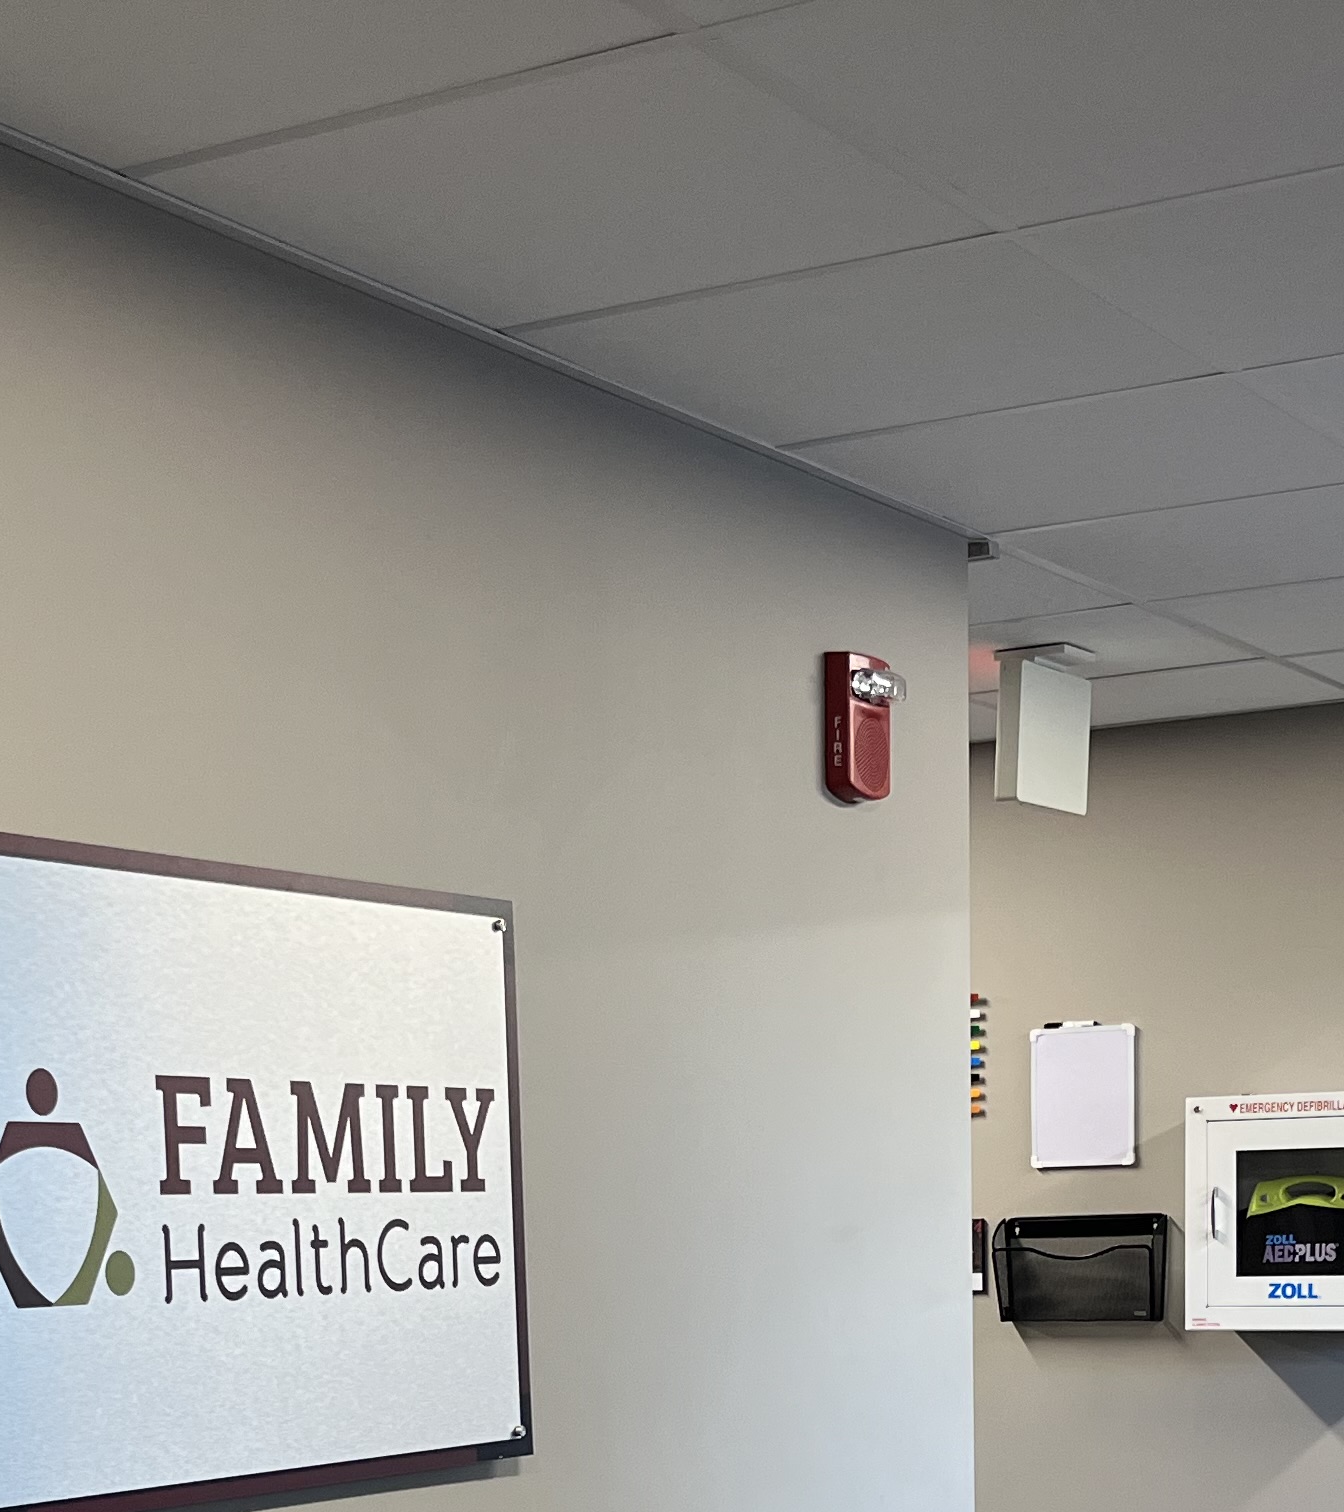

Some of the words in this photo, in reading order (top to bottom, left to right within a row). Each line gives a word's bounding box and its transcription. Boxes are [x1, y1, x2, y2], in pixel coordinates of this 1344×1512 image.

[833, 715, 843, 767] FIRE
[1239, 1102, 1295, 1114] EMERGENCY
[155, 1074, 495, 1196] FAMILY
[1265, 1234, 1297, 1245] ZOLL
[161, 1217, 501, 1304] HealthCare
[1268, 1283, 1319, 1299] ZOLL
